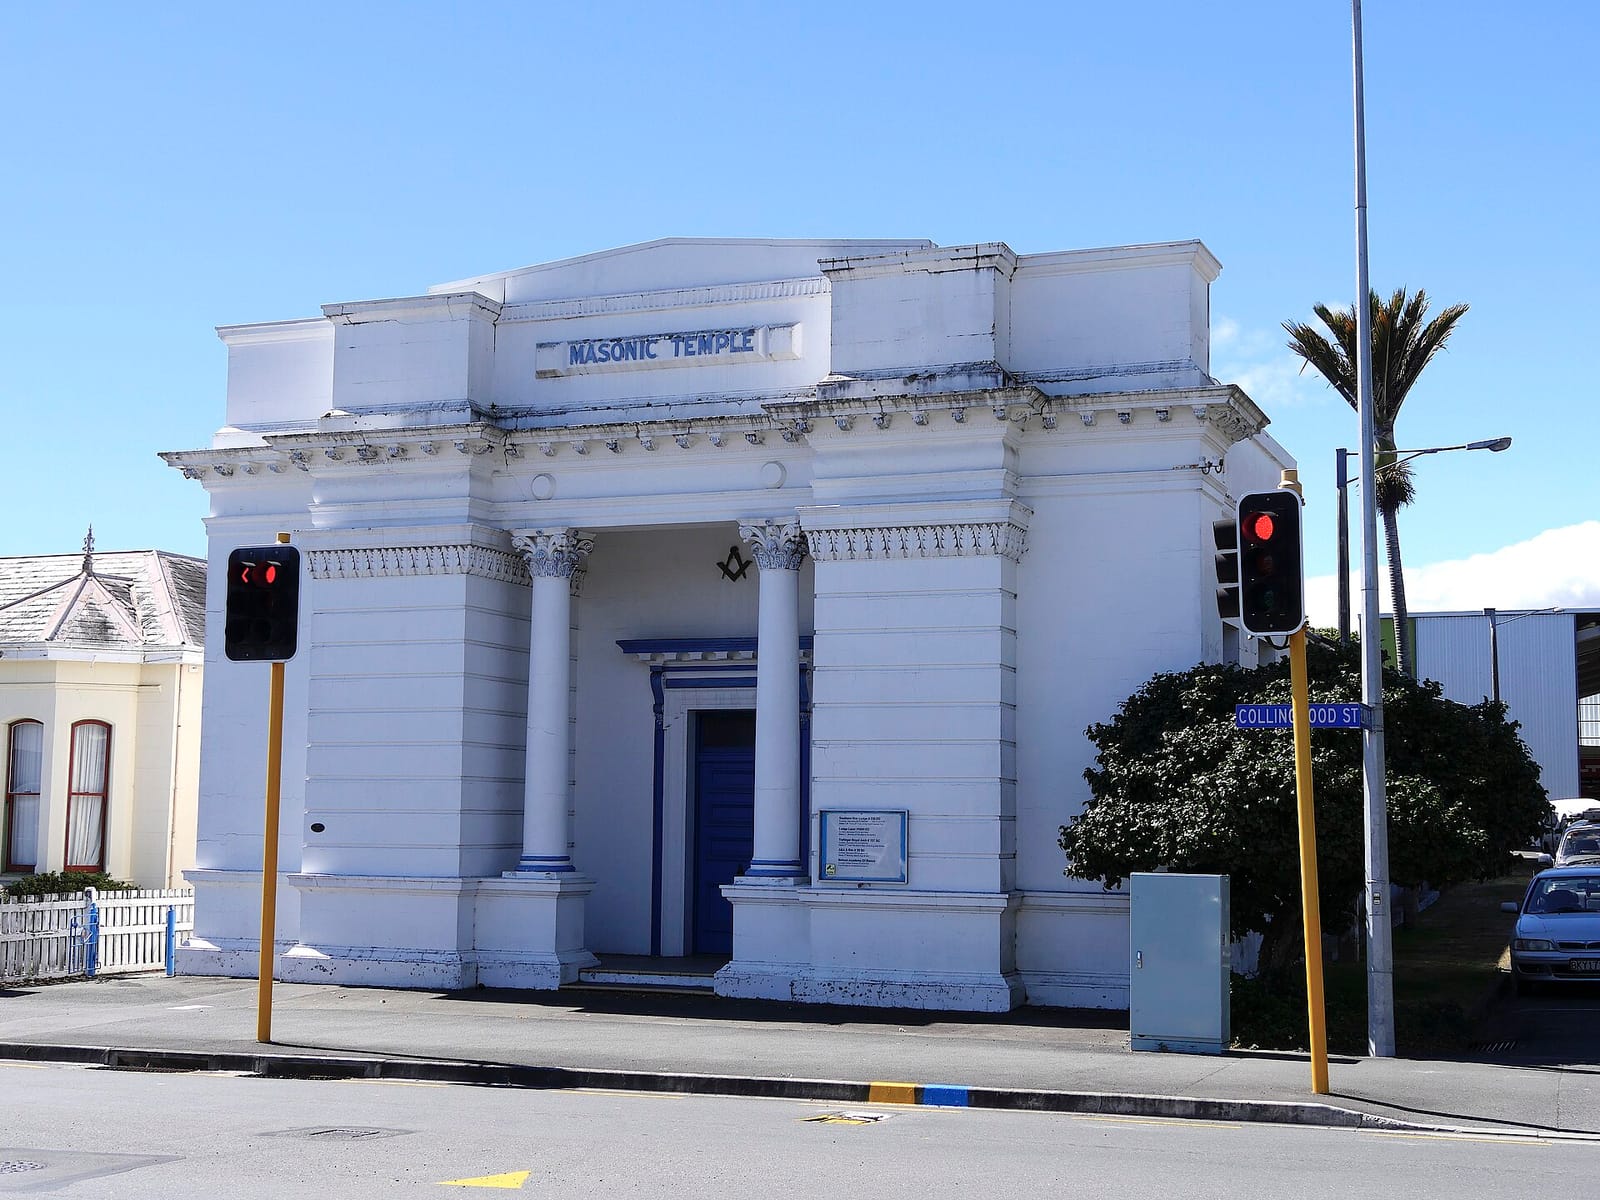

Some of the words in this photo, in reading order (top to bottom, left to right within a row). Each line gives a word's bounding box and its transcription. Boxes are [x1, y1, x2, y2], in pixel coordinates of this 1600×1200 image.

[570, 340, 658, 366] MASONIC
[672, 333, 755, 358] TEMPLE
[1239, 708, 1336, 723] COLLINOOD
[1343, 708, 1358, 723] ST
